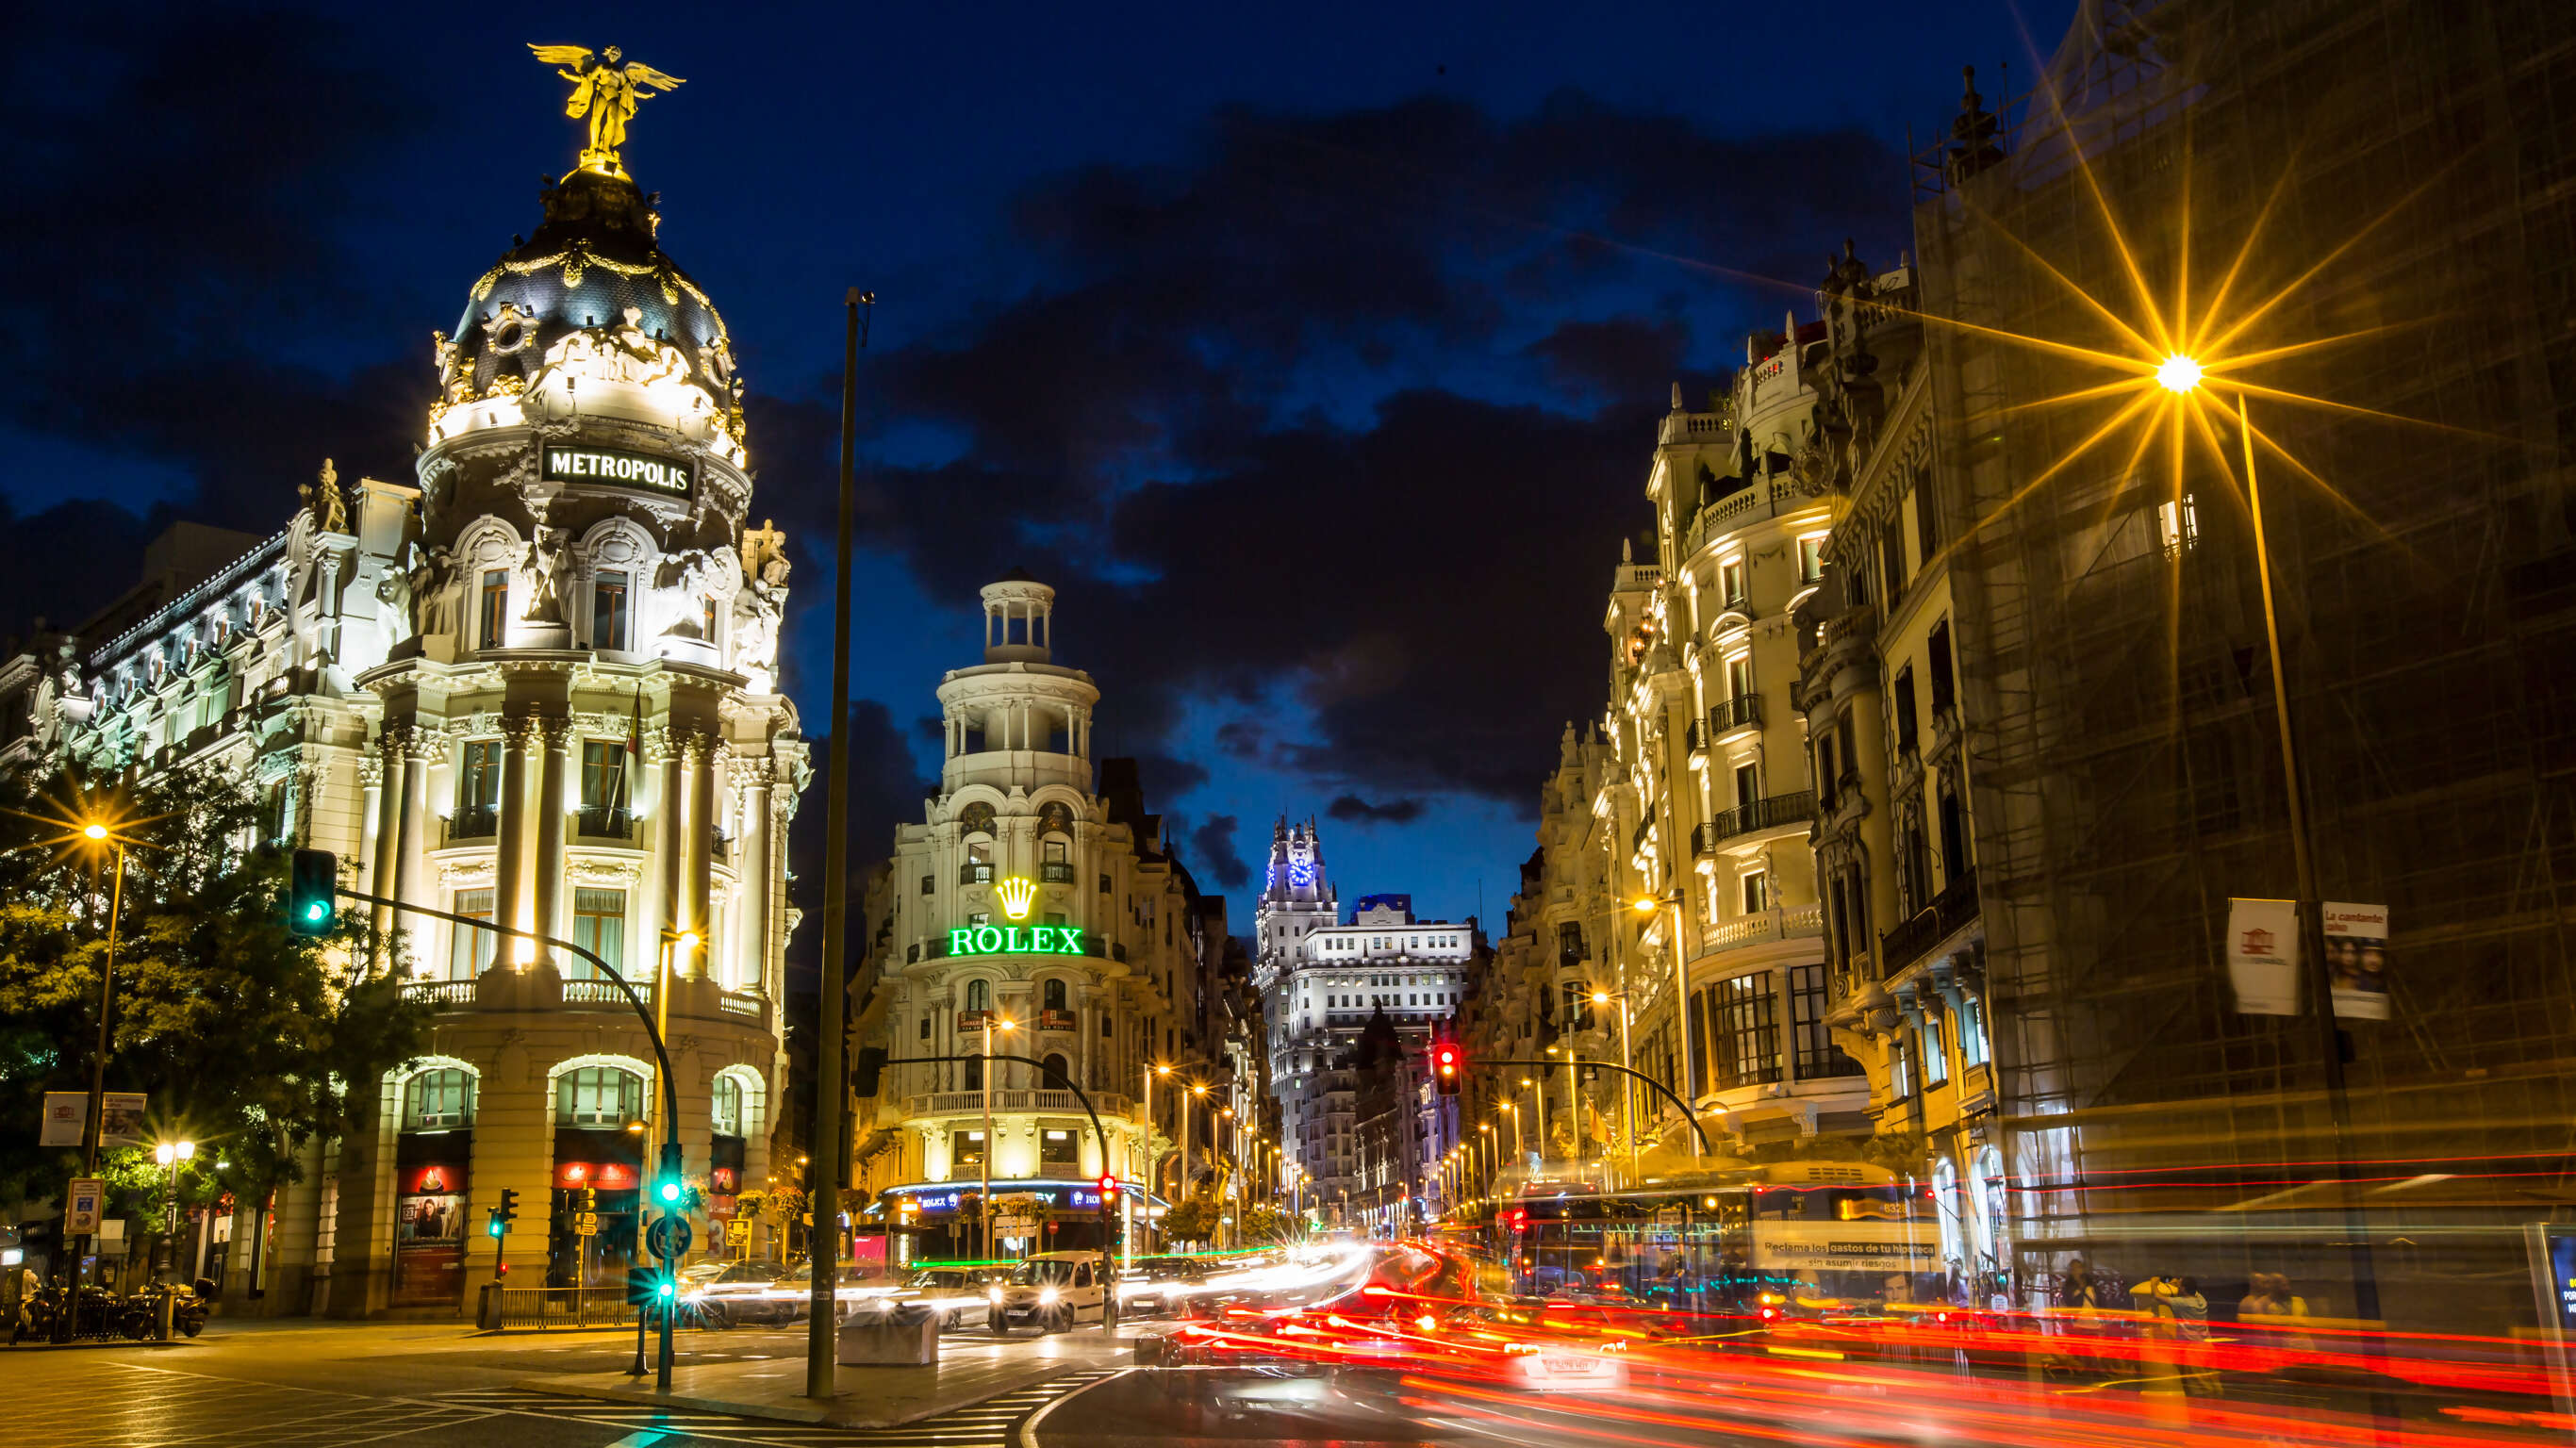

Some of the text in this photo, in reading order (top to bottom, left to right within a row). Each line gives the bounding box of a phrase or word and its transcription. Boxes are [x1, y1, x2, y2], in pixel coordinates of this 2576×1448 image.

[551, 452, 687, 491] METROPOLIS
[949, 927, 1084, 956] ROLEX
[1764, 1242, 1934, 1255] Reclama los gastos de tu hipoteca
[1808, 1258, 1897, 1269] sin asumir riesgos
